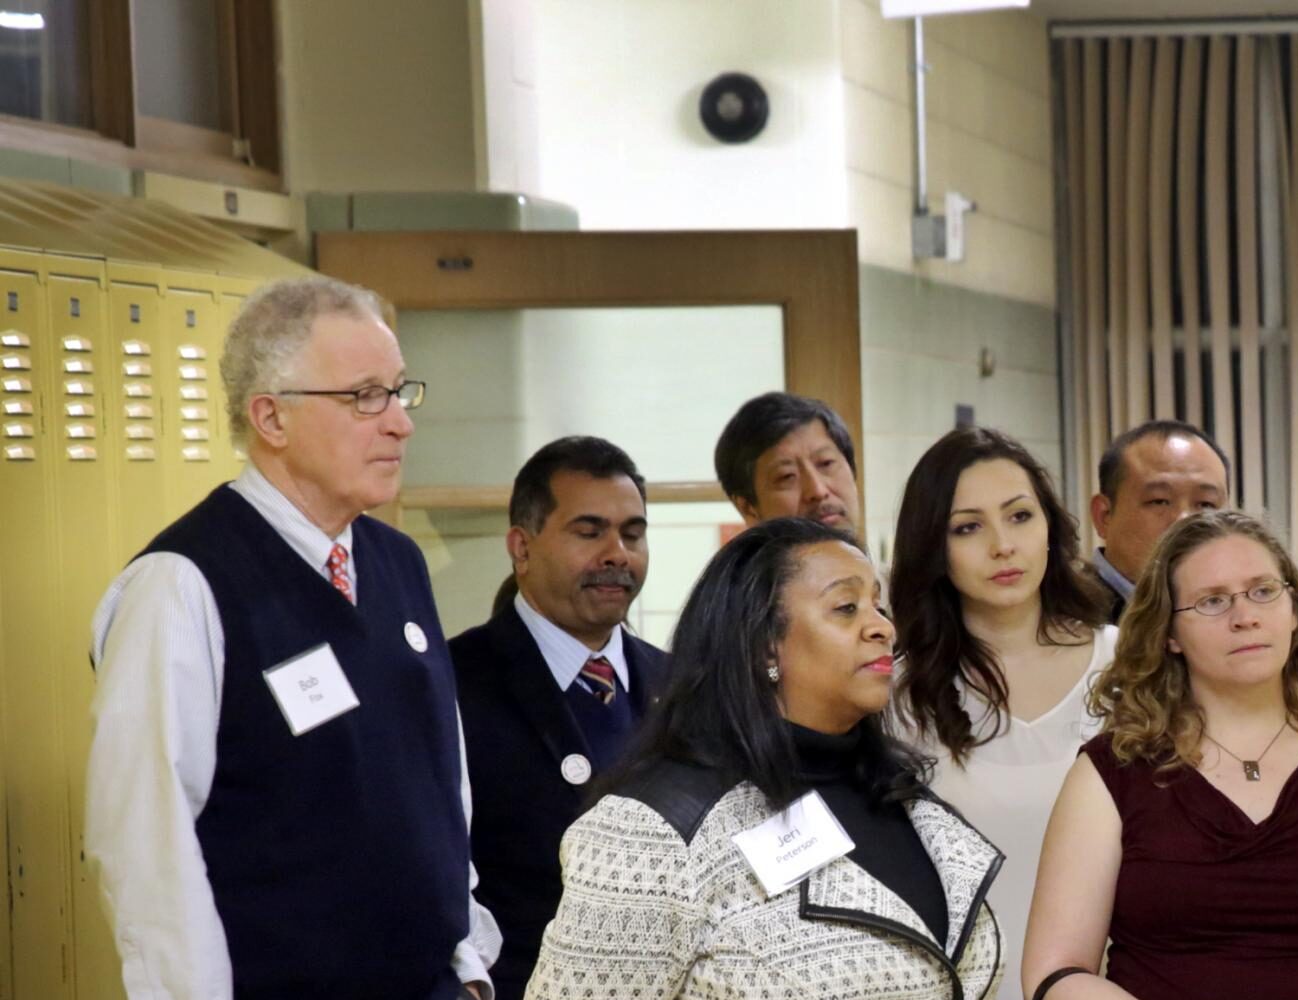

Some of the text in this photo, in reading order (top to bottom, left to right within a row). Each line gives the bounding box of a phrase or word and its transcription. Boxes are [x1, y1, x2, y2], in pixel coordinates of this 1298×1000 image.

[298, 675, 320, 692] Bob
[777, 827, 801, 848] Jeri
[775, 836, 818, 864] Peterson
